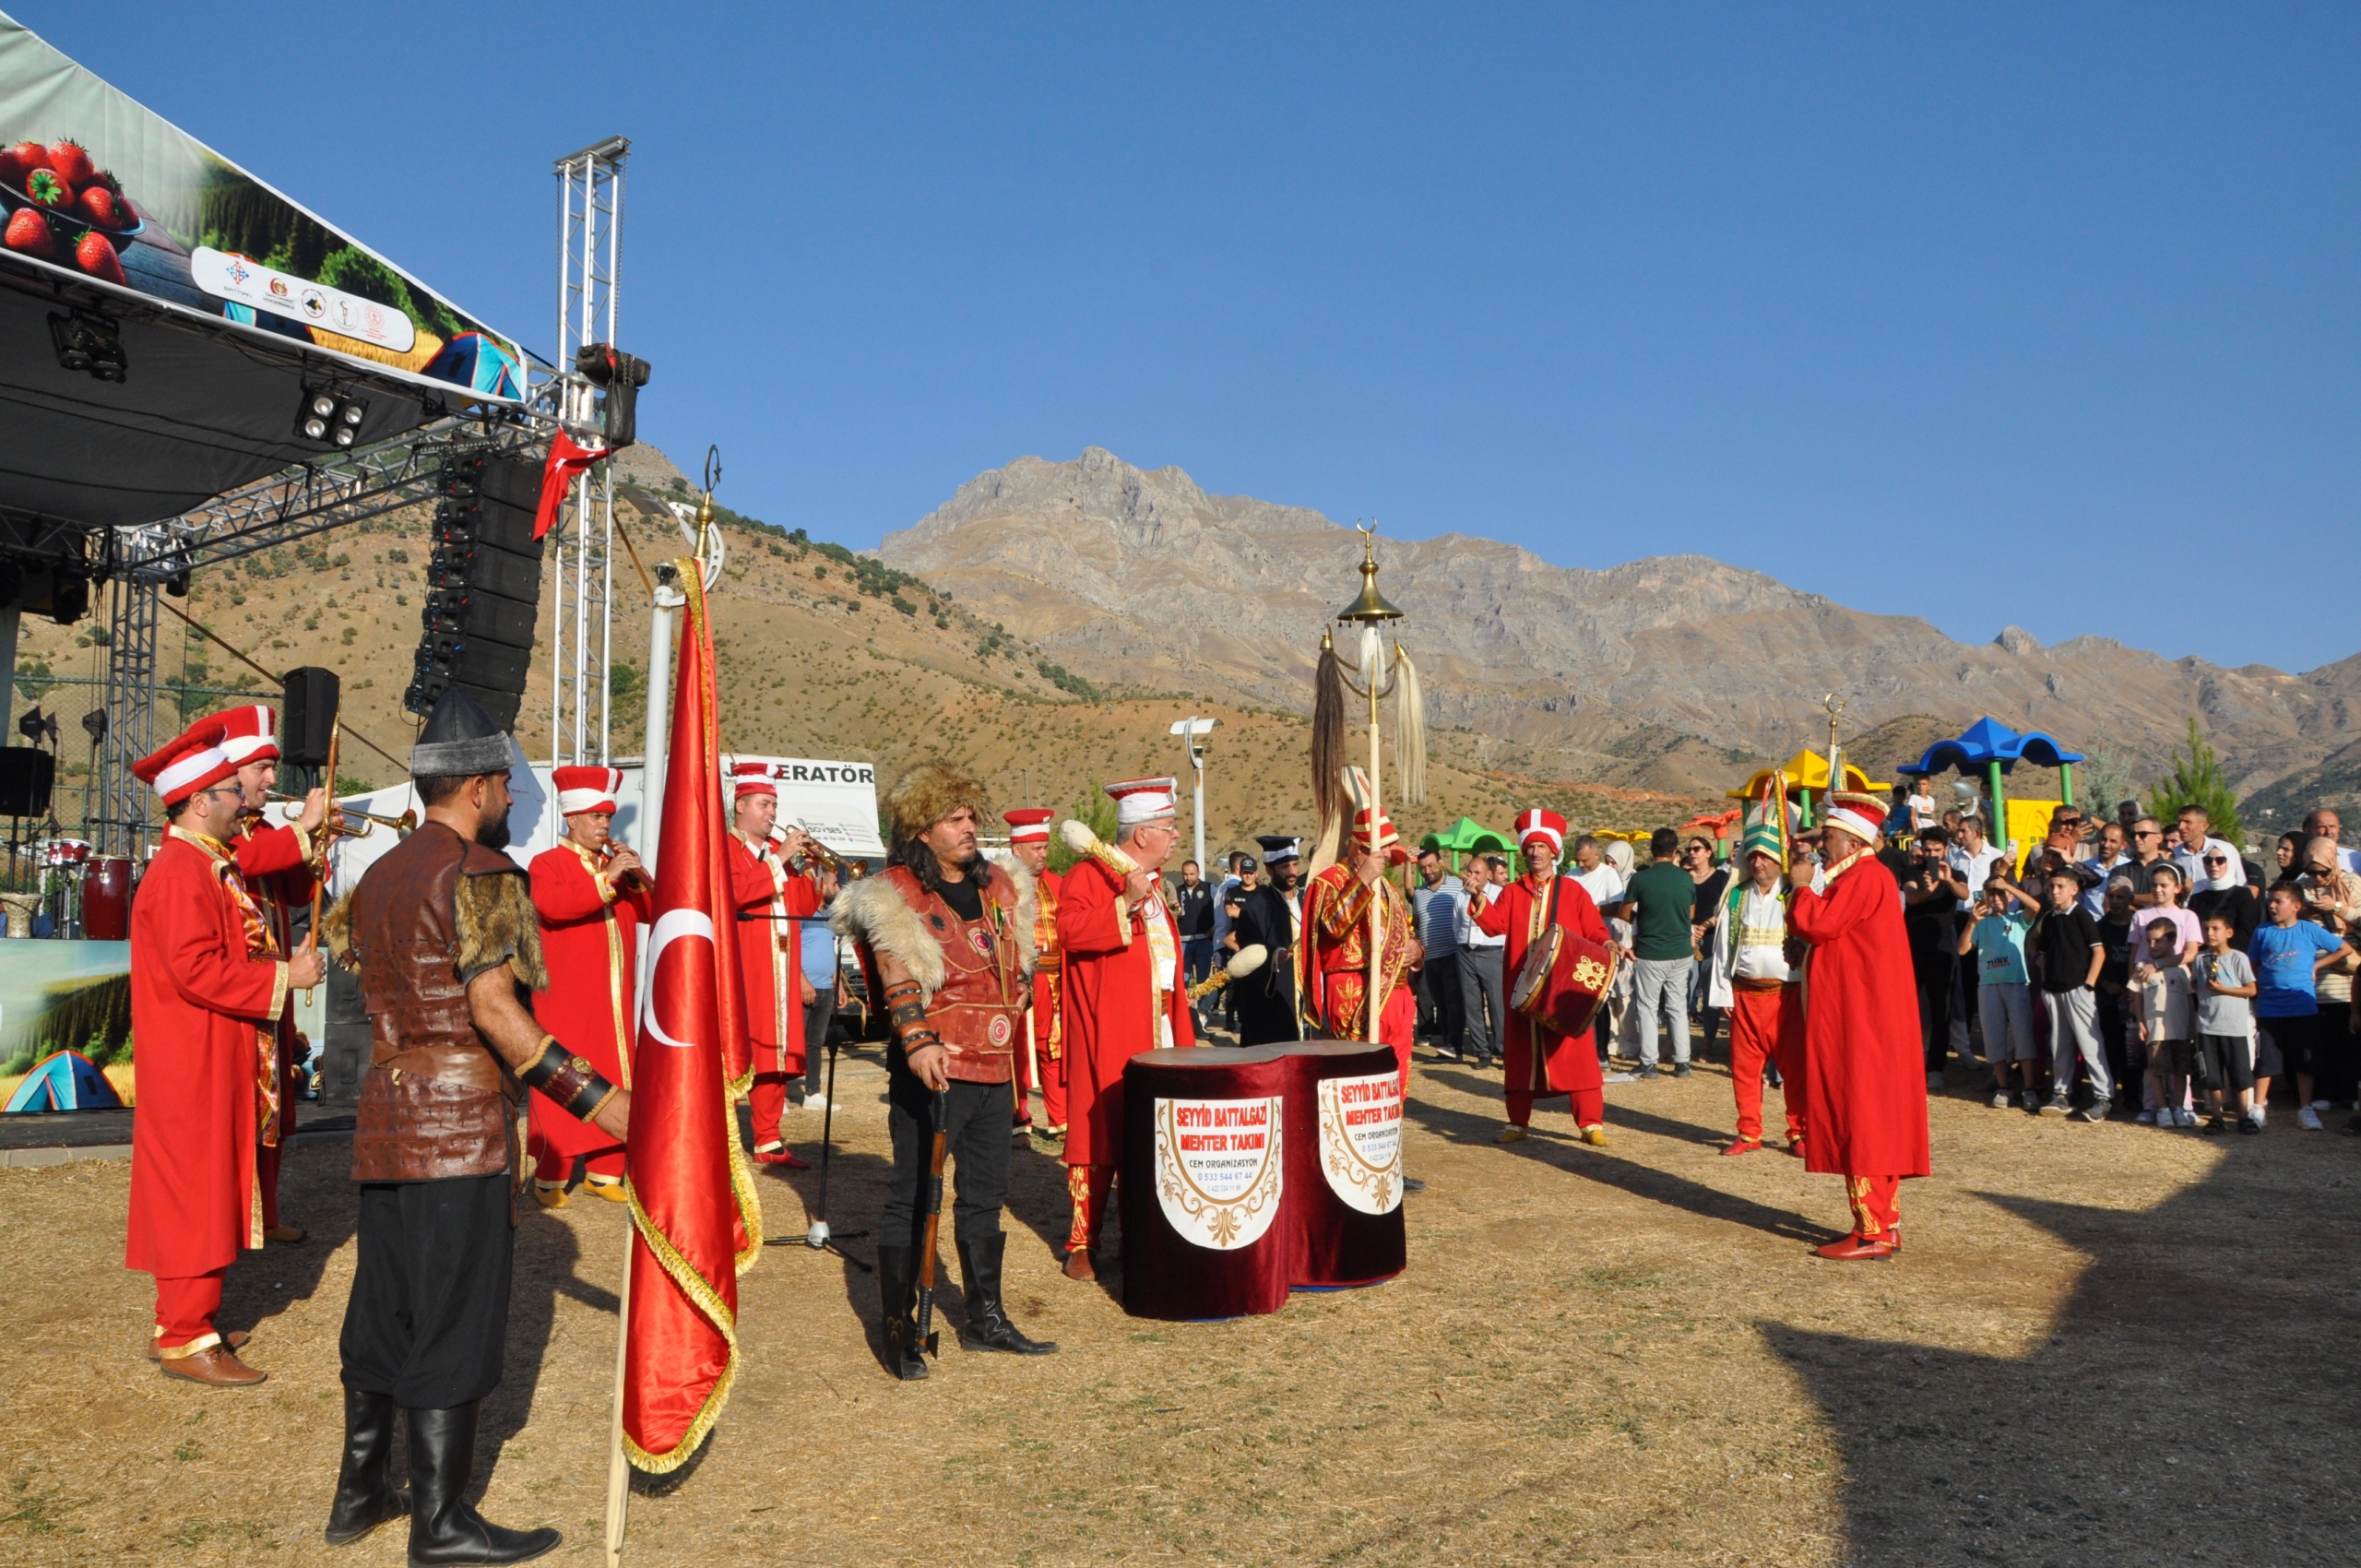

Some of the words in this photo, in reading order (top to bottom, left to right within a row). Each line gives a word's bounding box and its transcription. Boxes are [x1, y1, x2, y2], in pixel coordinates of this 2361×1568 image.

[722, 762, 875, 784] JERATÖR
[1341, 1079, 1370, 1104] SEYYİD
[1177, 1103, 1212, 1127] SEYYİD
[1215, 1100, 1267, 1127] BATTALGAZİ
[1346, 1107, 1382, 1126] MEHTER
[1180, 1134, 1228, 1151] MEHTER
[1230, 1133, 1264, 1151] TAKIMI
[1354, 1133, 1366, 1141] CEM
[1368, 1144, 1377, 1152] 533
[1189, 1159, 1204, 1169] CEM
[1205, 1158, 1258, 1169] ORGANİZASYON
[1219, 1172, 1233, 1181] 544
[1234, 1172, 1243, 1181] 67
